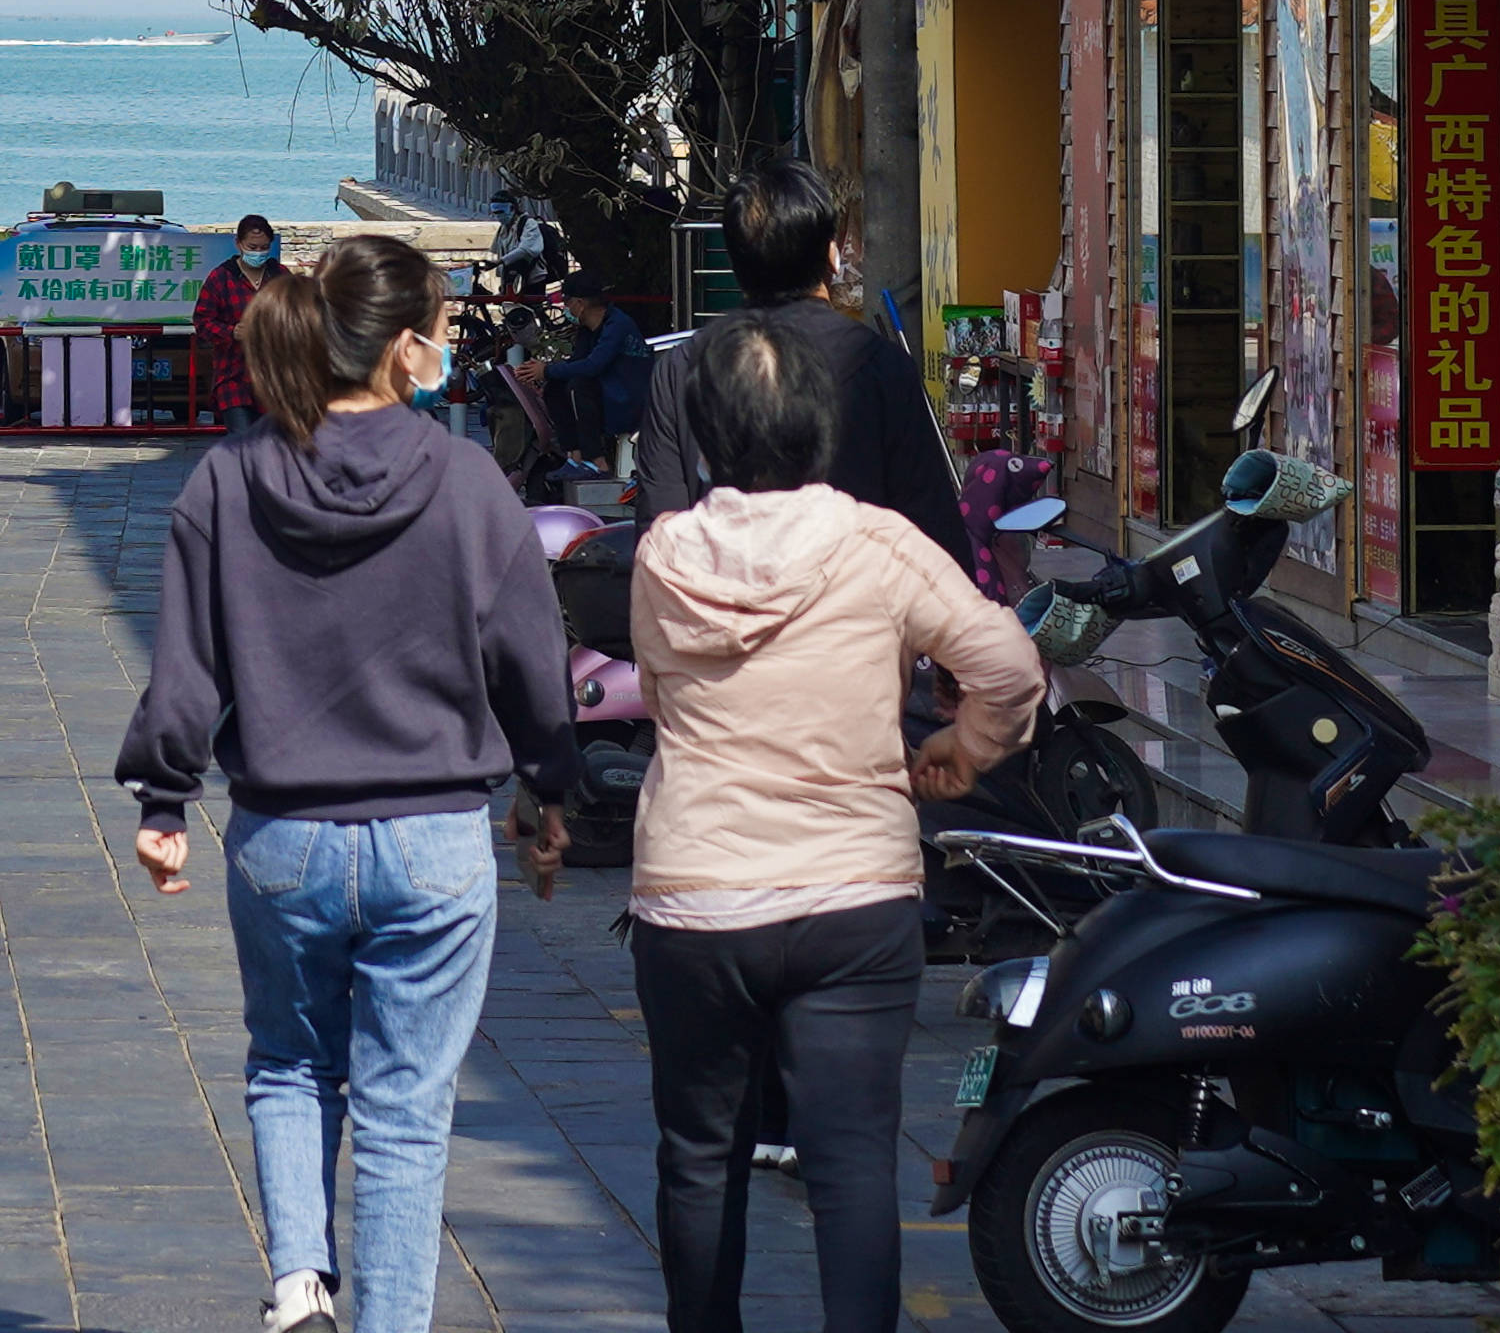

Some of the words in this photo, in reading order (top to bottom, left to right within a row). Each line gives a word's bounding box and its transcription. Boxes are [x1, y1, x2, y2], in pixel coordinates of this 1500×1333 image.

[18, 244, 101, 271] 戴口罩
[119, 244, 203, 271] 勤洗手
